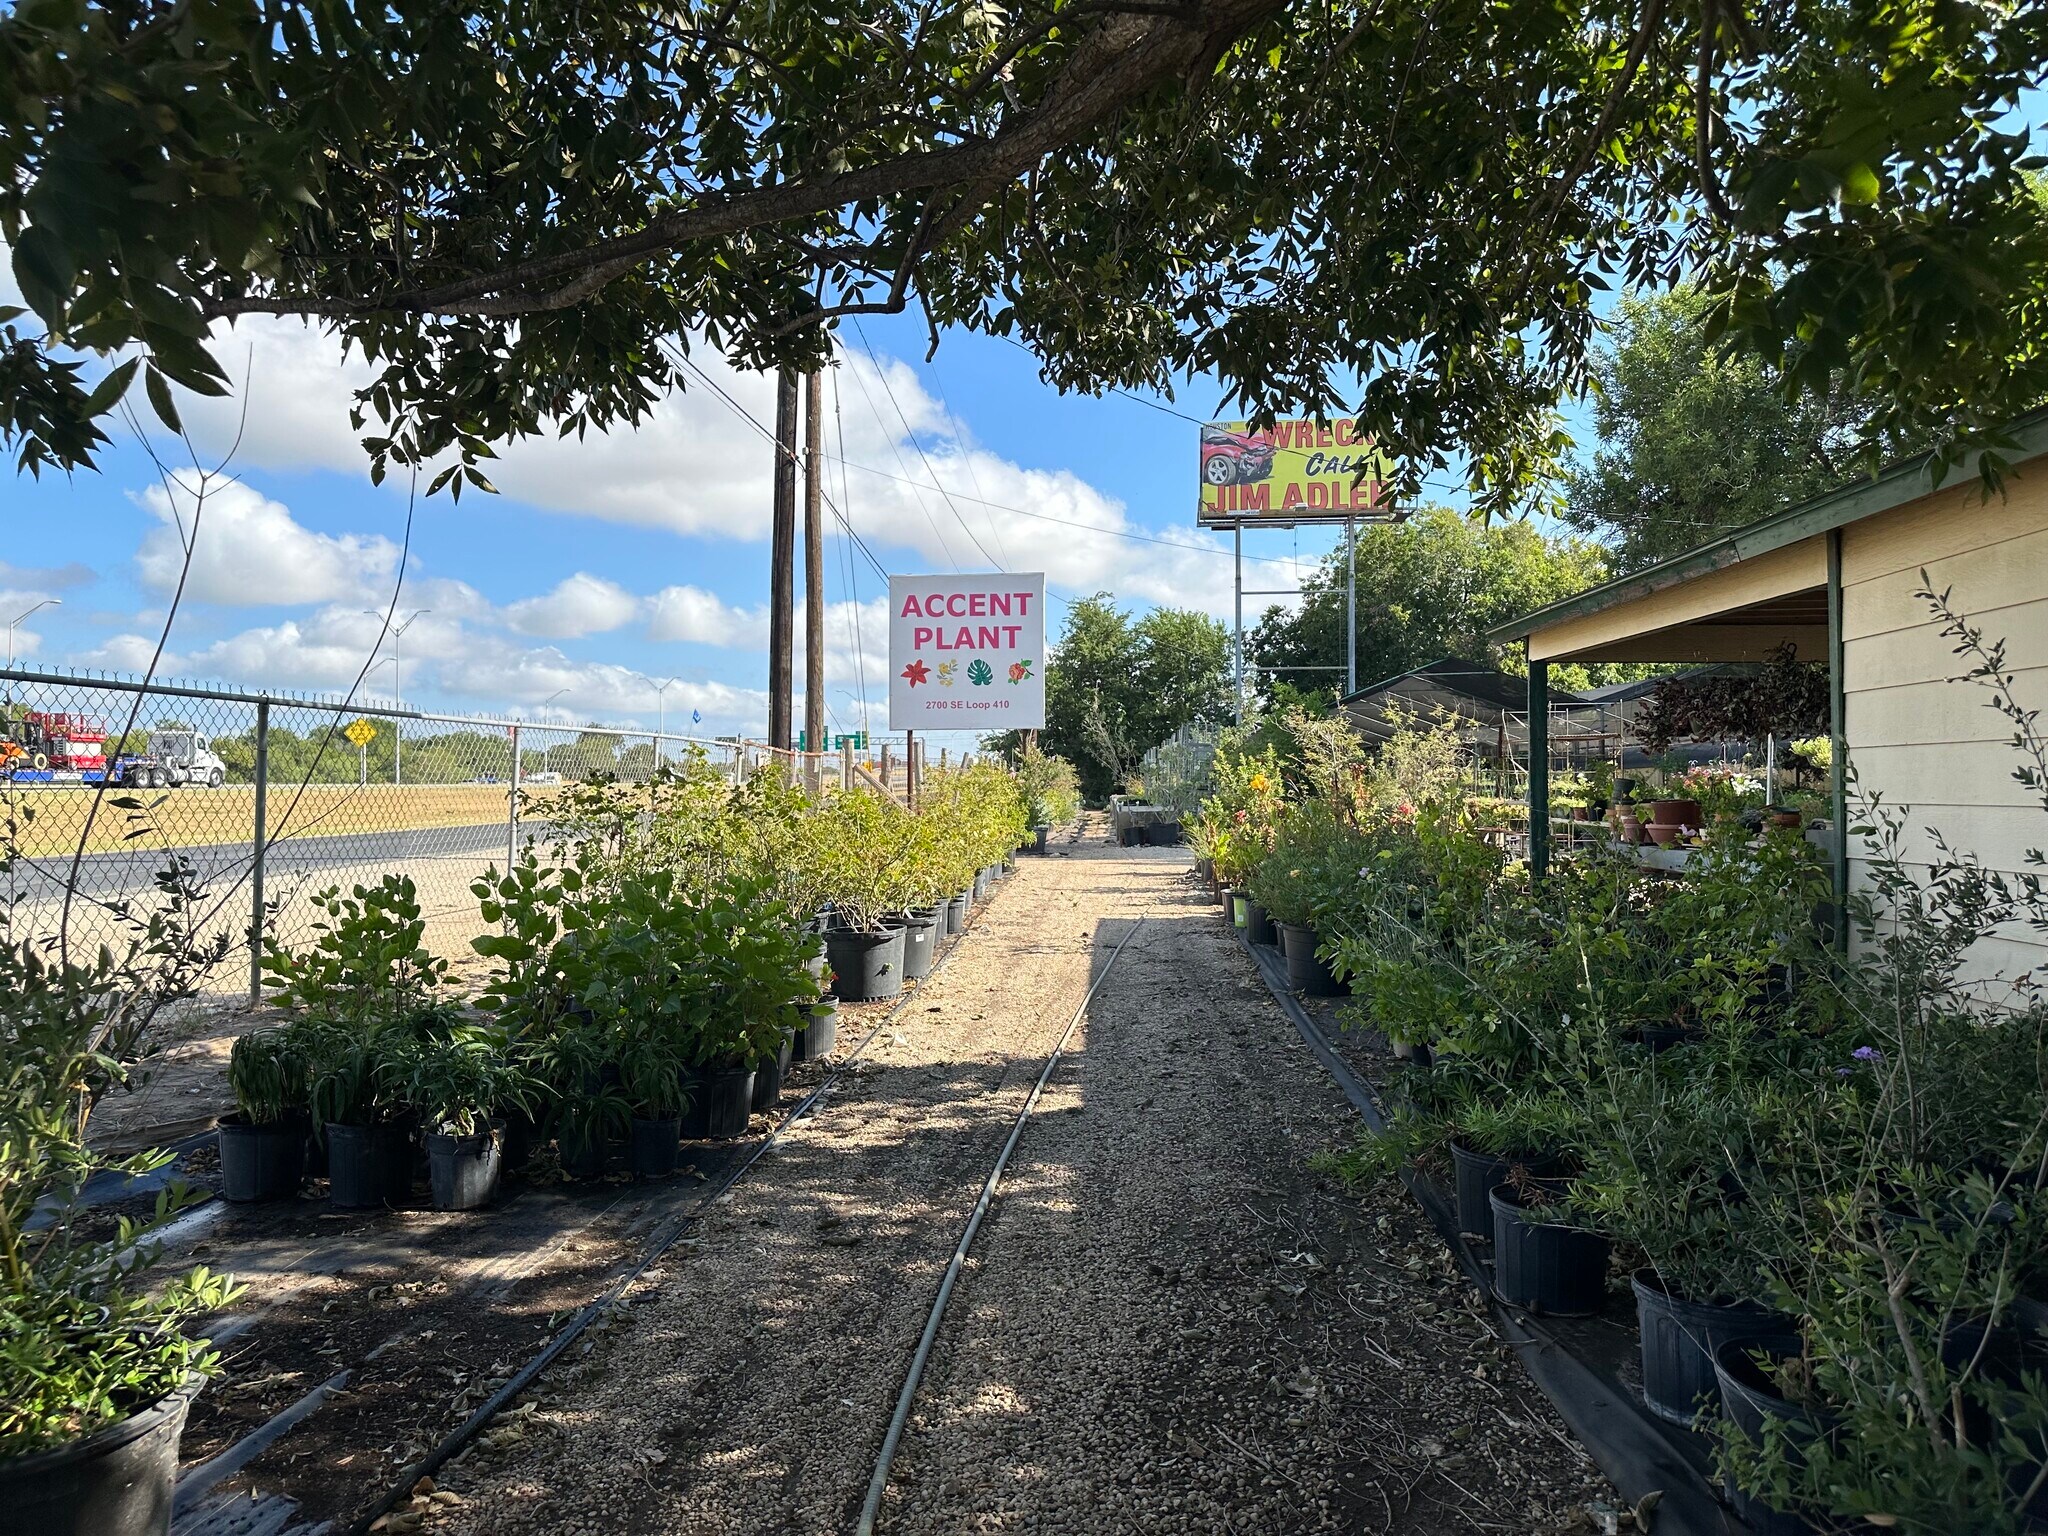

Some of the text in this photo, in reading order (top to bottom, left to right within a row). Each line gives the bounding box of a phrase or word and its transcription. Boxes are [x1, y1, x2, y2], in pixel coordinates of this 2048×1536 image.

[1206, 480, 1391, 512] JIM ADLER
[901, 593, 1034, 618] ACCENT
[914, 626, 1023, 650] PLANT
[925, 700, 1010, 711] 2700 SE Loop 410
